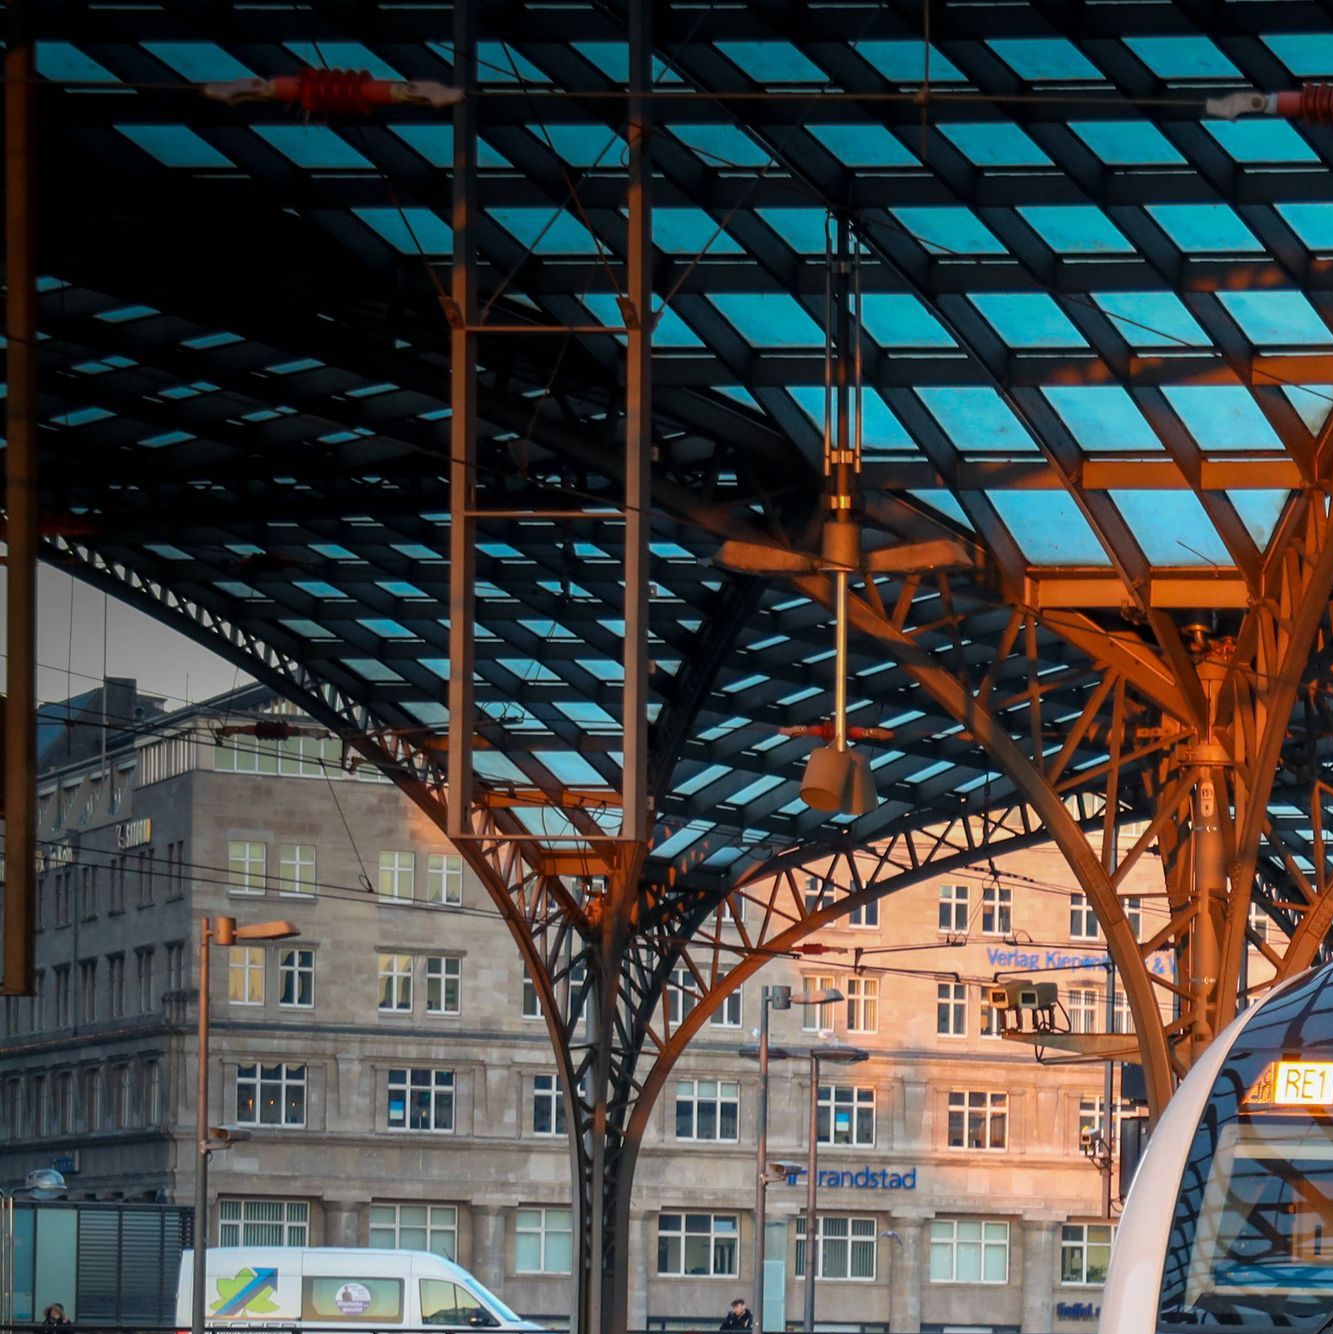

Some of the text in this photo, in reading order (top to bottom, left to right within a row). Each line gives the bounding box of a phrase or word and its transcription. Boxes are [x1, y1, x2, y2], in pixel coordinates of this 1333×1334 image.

[987, 947, 1040, 970] Verlag
[1284, 1068, 1326, 1100] RE1
[817, 1165, 917, 1190] randstad
